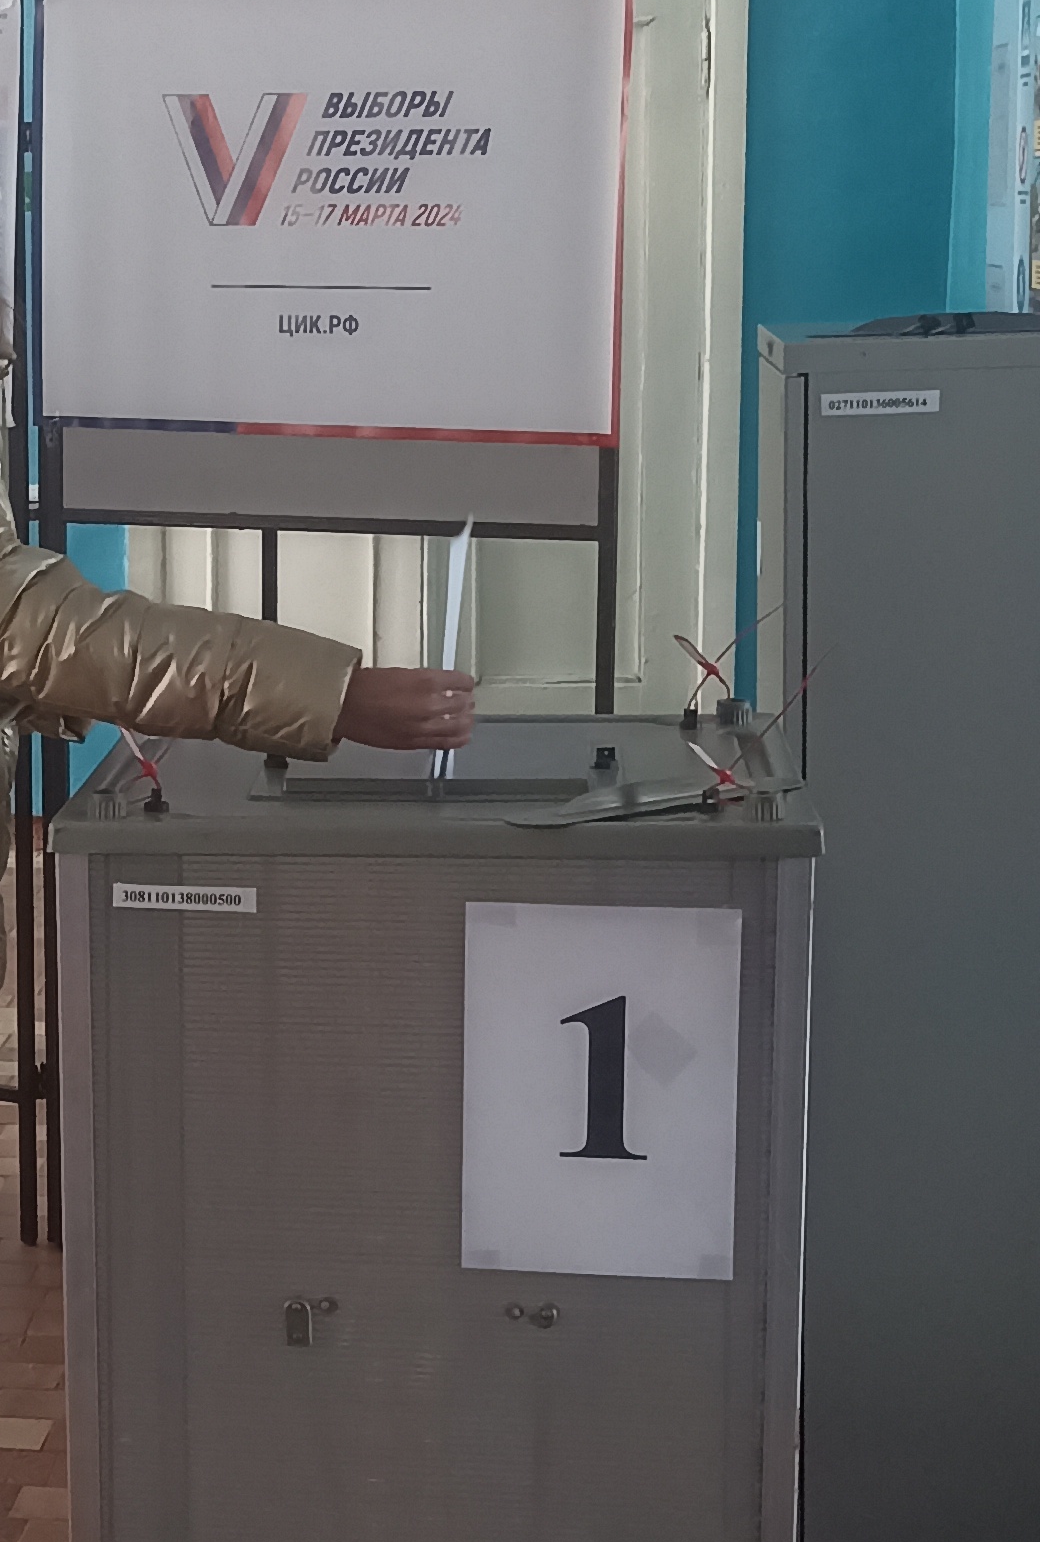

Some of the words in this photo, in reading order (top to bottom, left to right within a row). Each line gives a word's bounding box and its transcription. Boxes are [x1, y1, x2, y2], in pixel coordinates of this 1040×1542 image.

[321, 90, 454, 119] ВЫБОРЫ
[306, 127, 492, 160] ПРЕЗИДЕНТА
[291, 166, 411, 194] РОССИИ
[337, 203, 408, 227] МАРТА
[411, 203, 463, 227] 2024
[278, 313, 360, 336] ЦИК.РФ
[121, 889, 242, 906] 308110138000500
[559, 995, 648, 1161] 1
